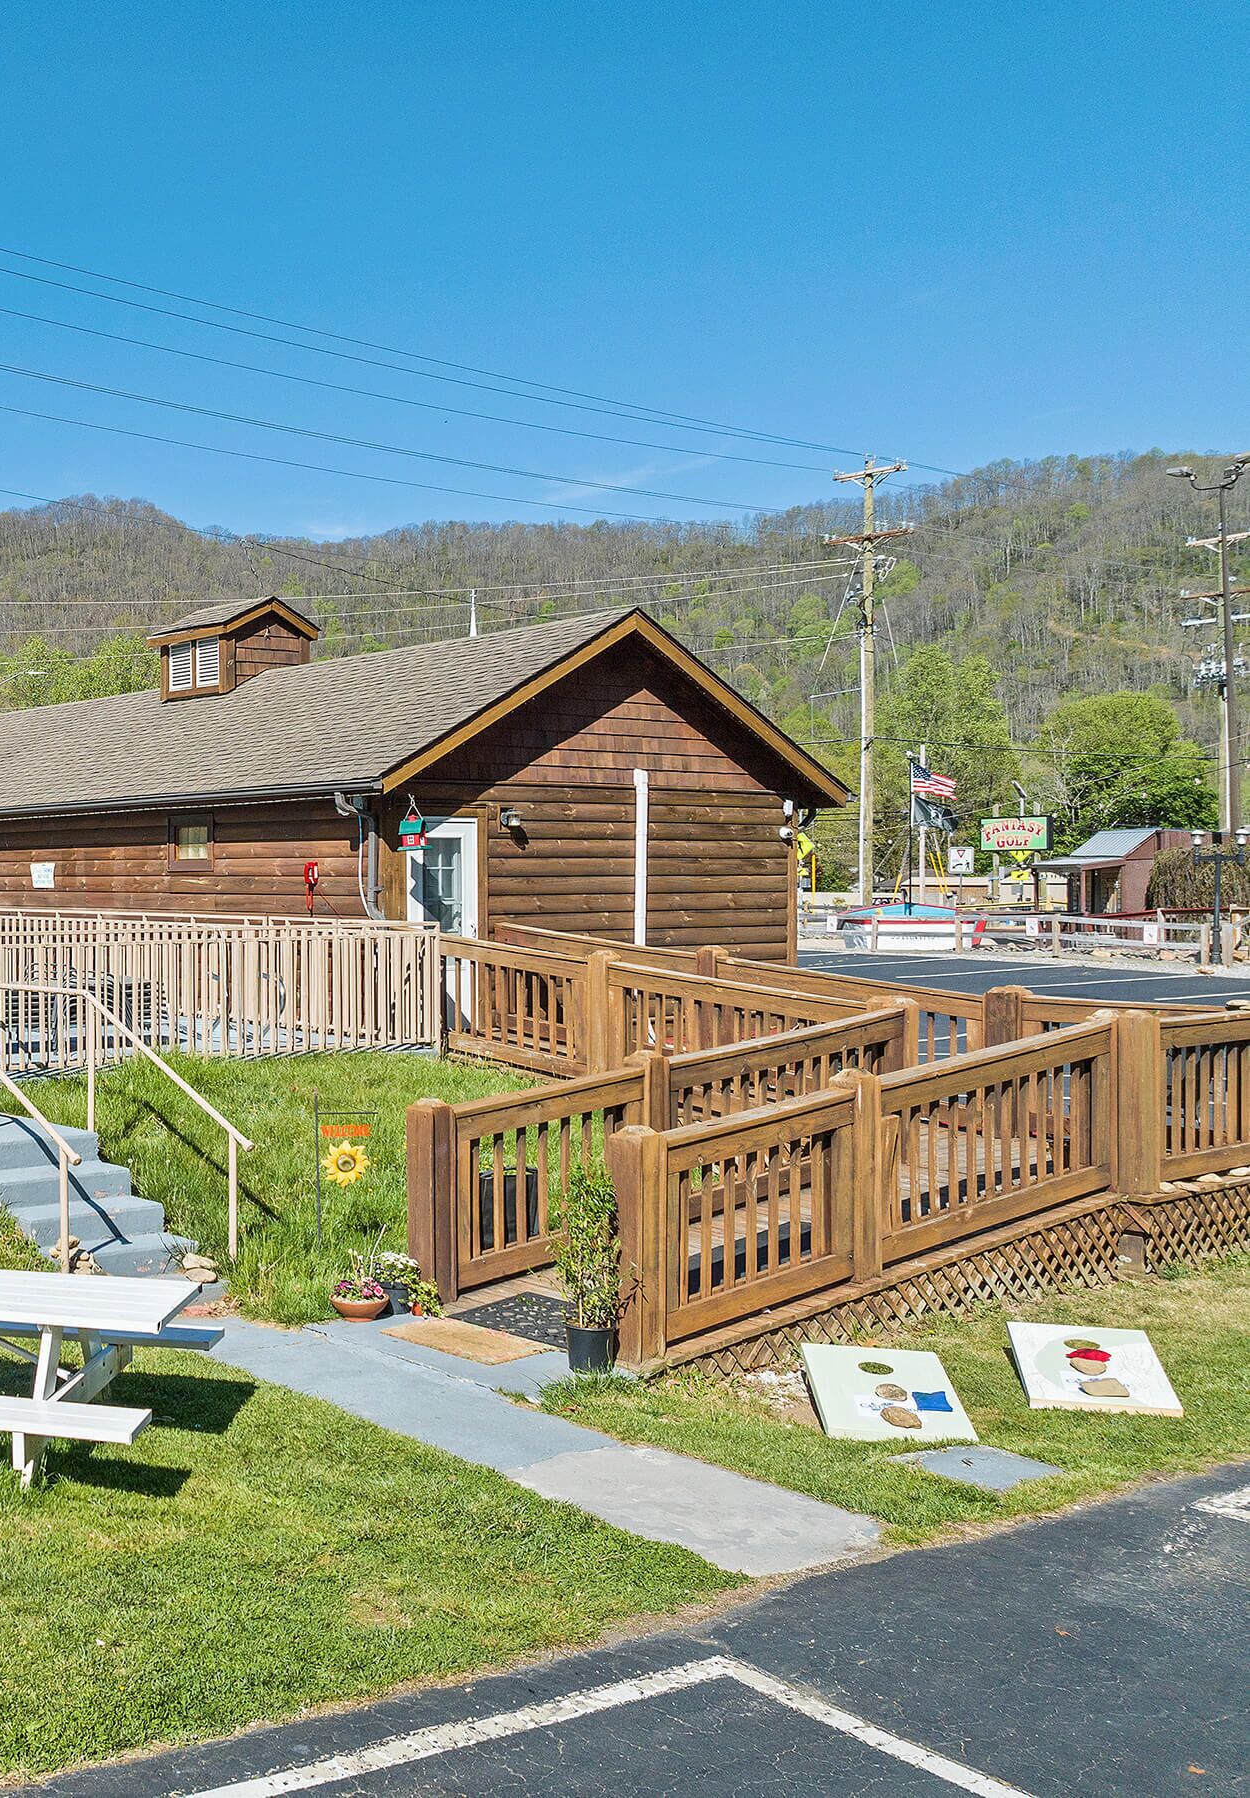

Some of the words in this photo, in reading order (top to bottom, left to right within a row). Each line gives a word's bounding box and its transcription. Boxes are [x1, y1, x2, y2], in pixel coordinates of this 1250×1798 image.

[981, 819, 1045, 842] FANTASY
[995, 834, 1032, 848] GOLF
[319, 1124, 371, 1137] WELCOME
